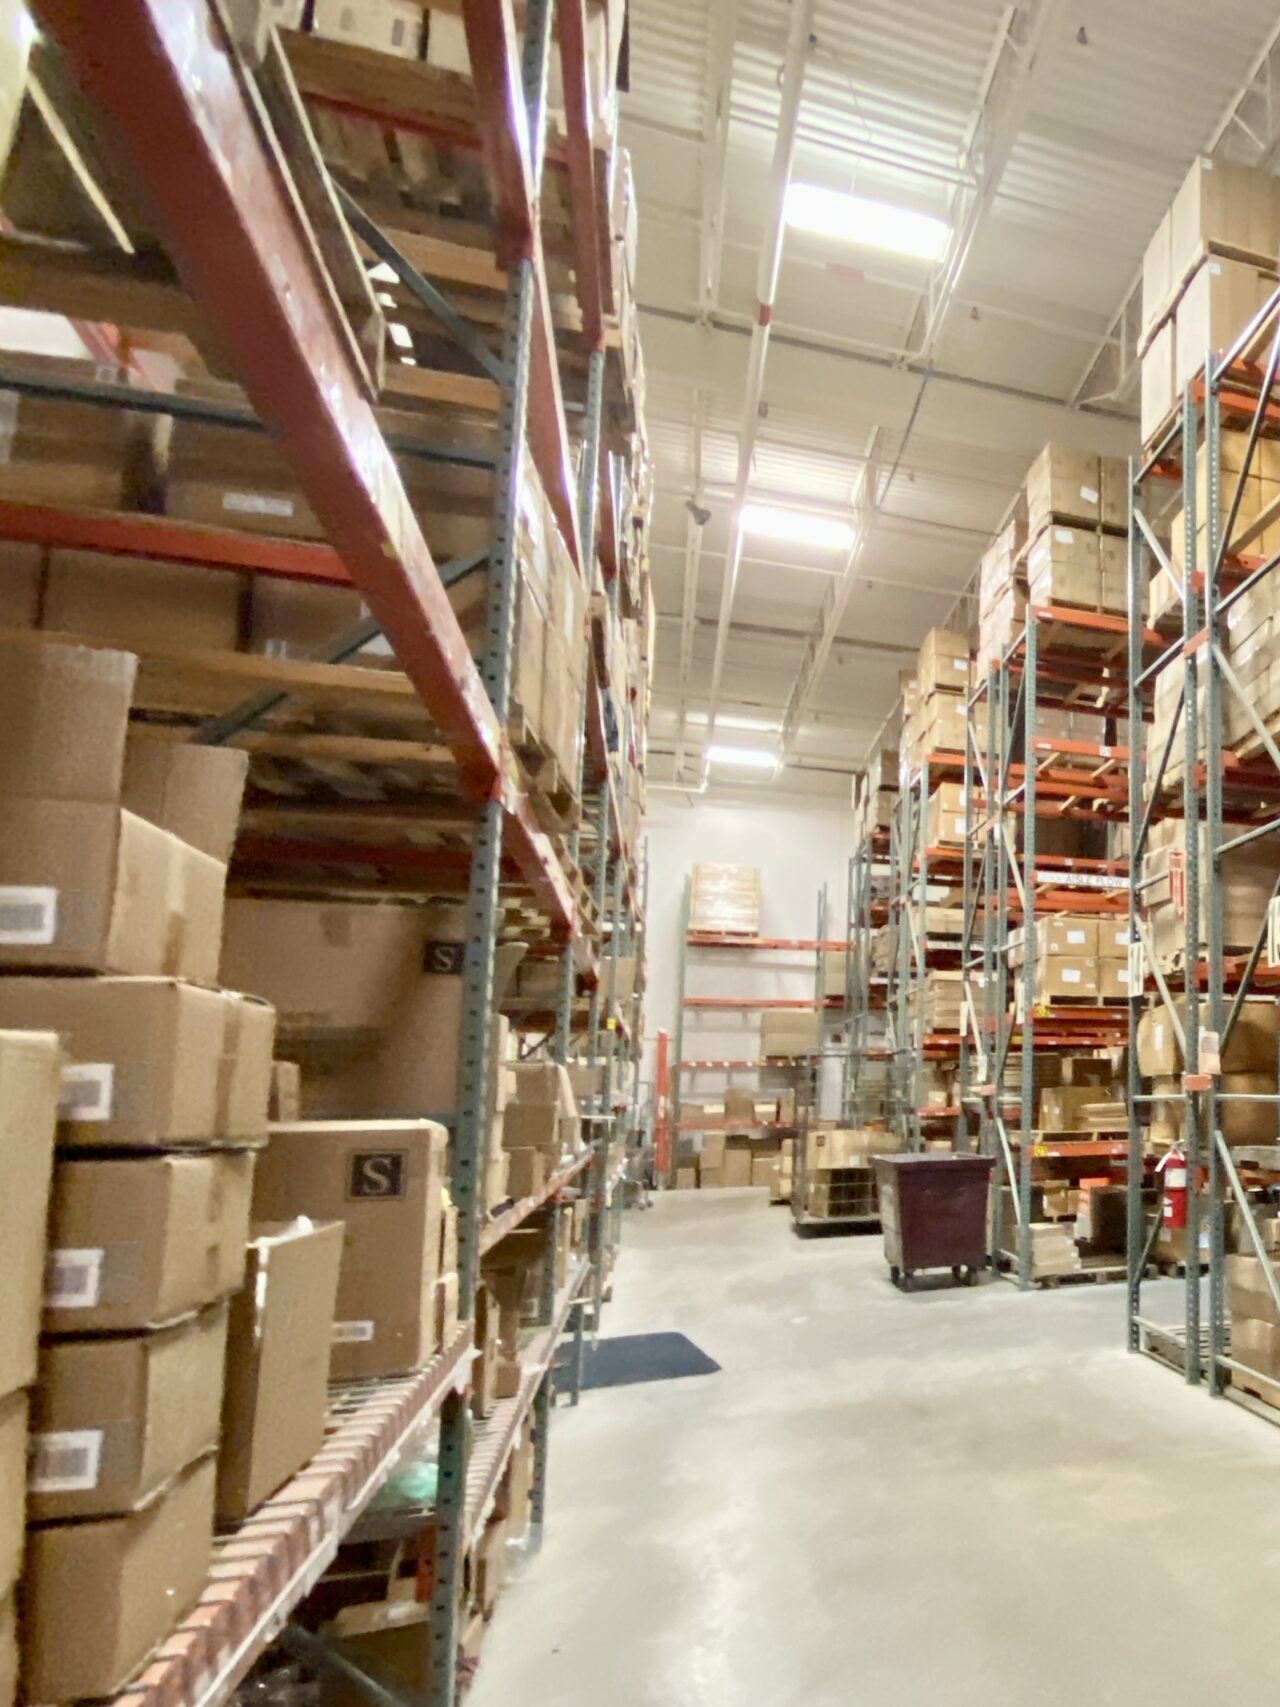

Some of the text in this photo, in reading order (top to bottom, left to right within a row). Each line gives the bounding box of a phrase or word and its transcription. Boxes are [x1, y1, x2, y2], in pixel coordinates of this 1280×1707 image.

[1066, 875, 1090, 884] AISLE
[1096, 876, 1123, 887] FLOW
[434, 946, 455, 972] S
[363, 1157, 391, 1195] S
